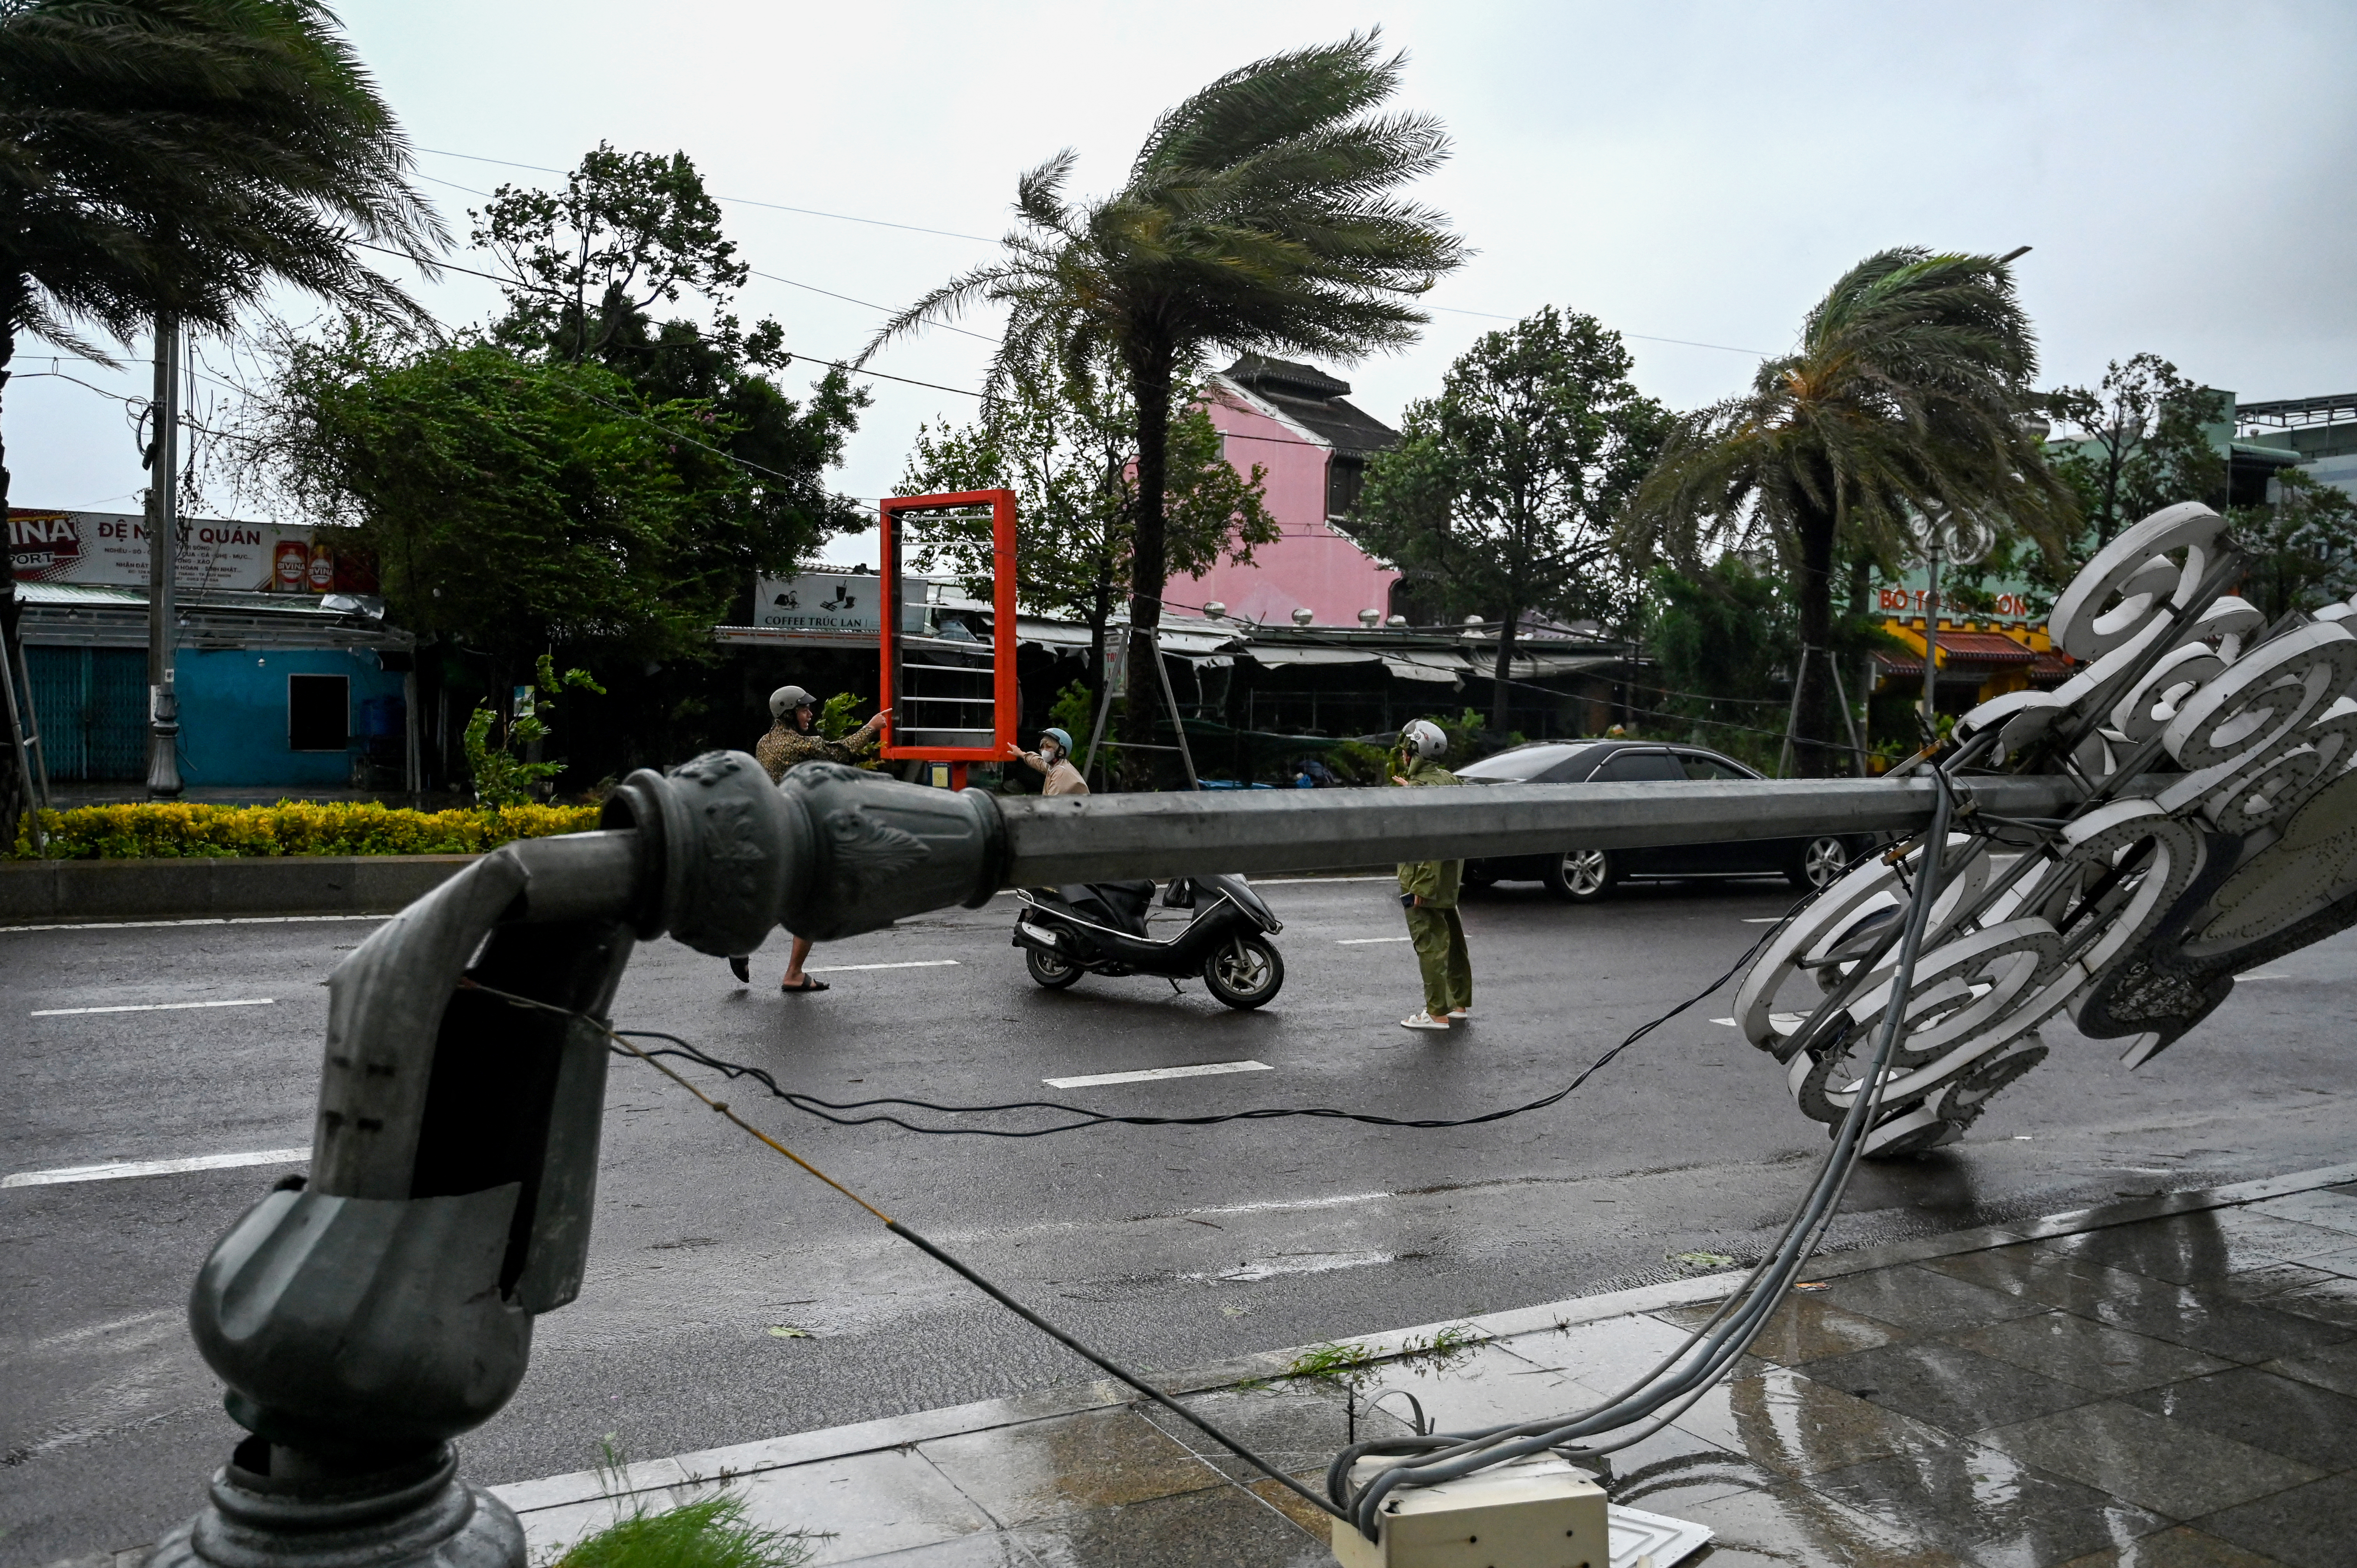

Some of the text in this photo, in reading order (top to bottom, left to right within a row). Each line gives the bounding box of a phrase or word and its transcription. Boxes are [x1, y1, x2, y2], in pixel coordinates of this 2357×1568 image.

[9, 519, 76, 544] INA
[98, 519, 127, 542] ĐỆ
[199, 526, 260, 545] QUÁN
[9, 552, 53, 564] PORT
[765, 616, 806, 626] COFFEE
[808, 615, 837, 627] TRÚC
[841, 618, 862, 627] LAN
